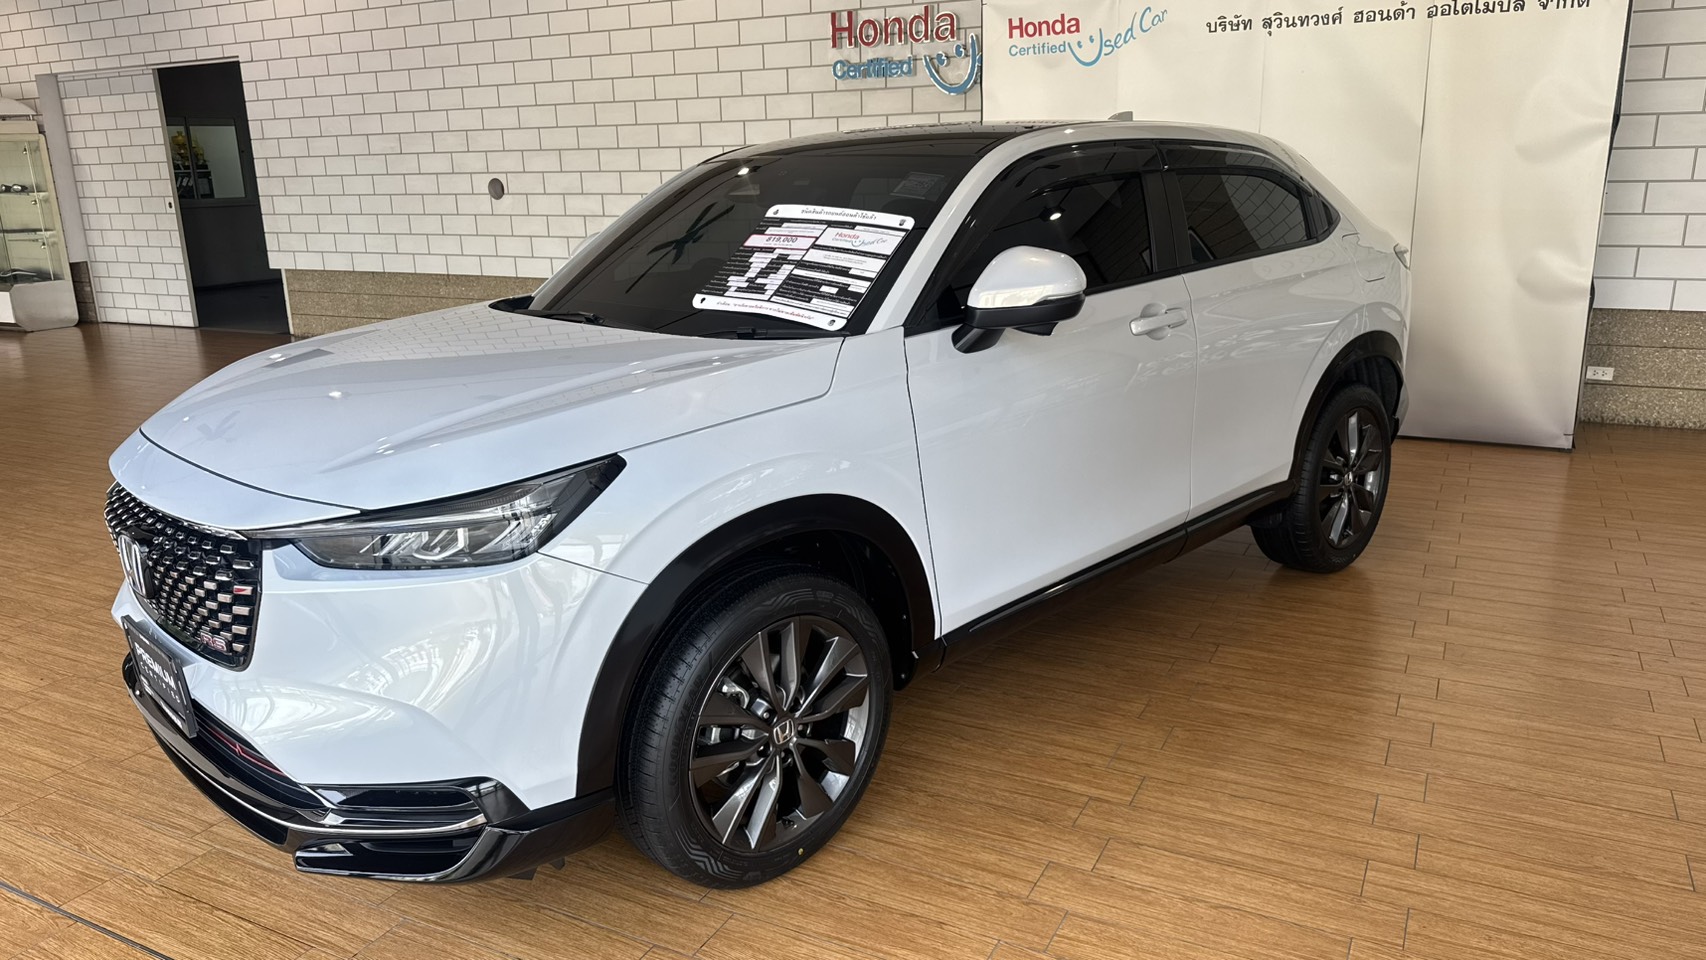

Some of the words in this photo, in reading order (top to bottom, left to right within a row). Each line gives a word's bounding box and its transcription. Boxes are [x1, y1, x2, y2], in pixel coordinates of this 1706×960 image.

[830, 5, 957, 48] Honda
[1008, 13, 1081, 39] Honda
[1206, 14, 1253, 34] บริษัท
[1262, 6, 1344, 37] สุวินทวงศ์
[1353, 0, 1416, 24] ฮอนด้า
[1426, 0, 1526, 18] ออโตโมบล
[1008, 41, 1067, 57] Certified
[1139, 7, 1169, 32] Car
[832, 55, 914, 80] Certified
[765, 236, 799, 244] 819,000
[834, 231, 860, 240] Honda
[200, 632, 227, 652] RS
[134, 641, 177, 690] PREMIUM
